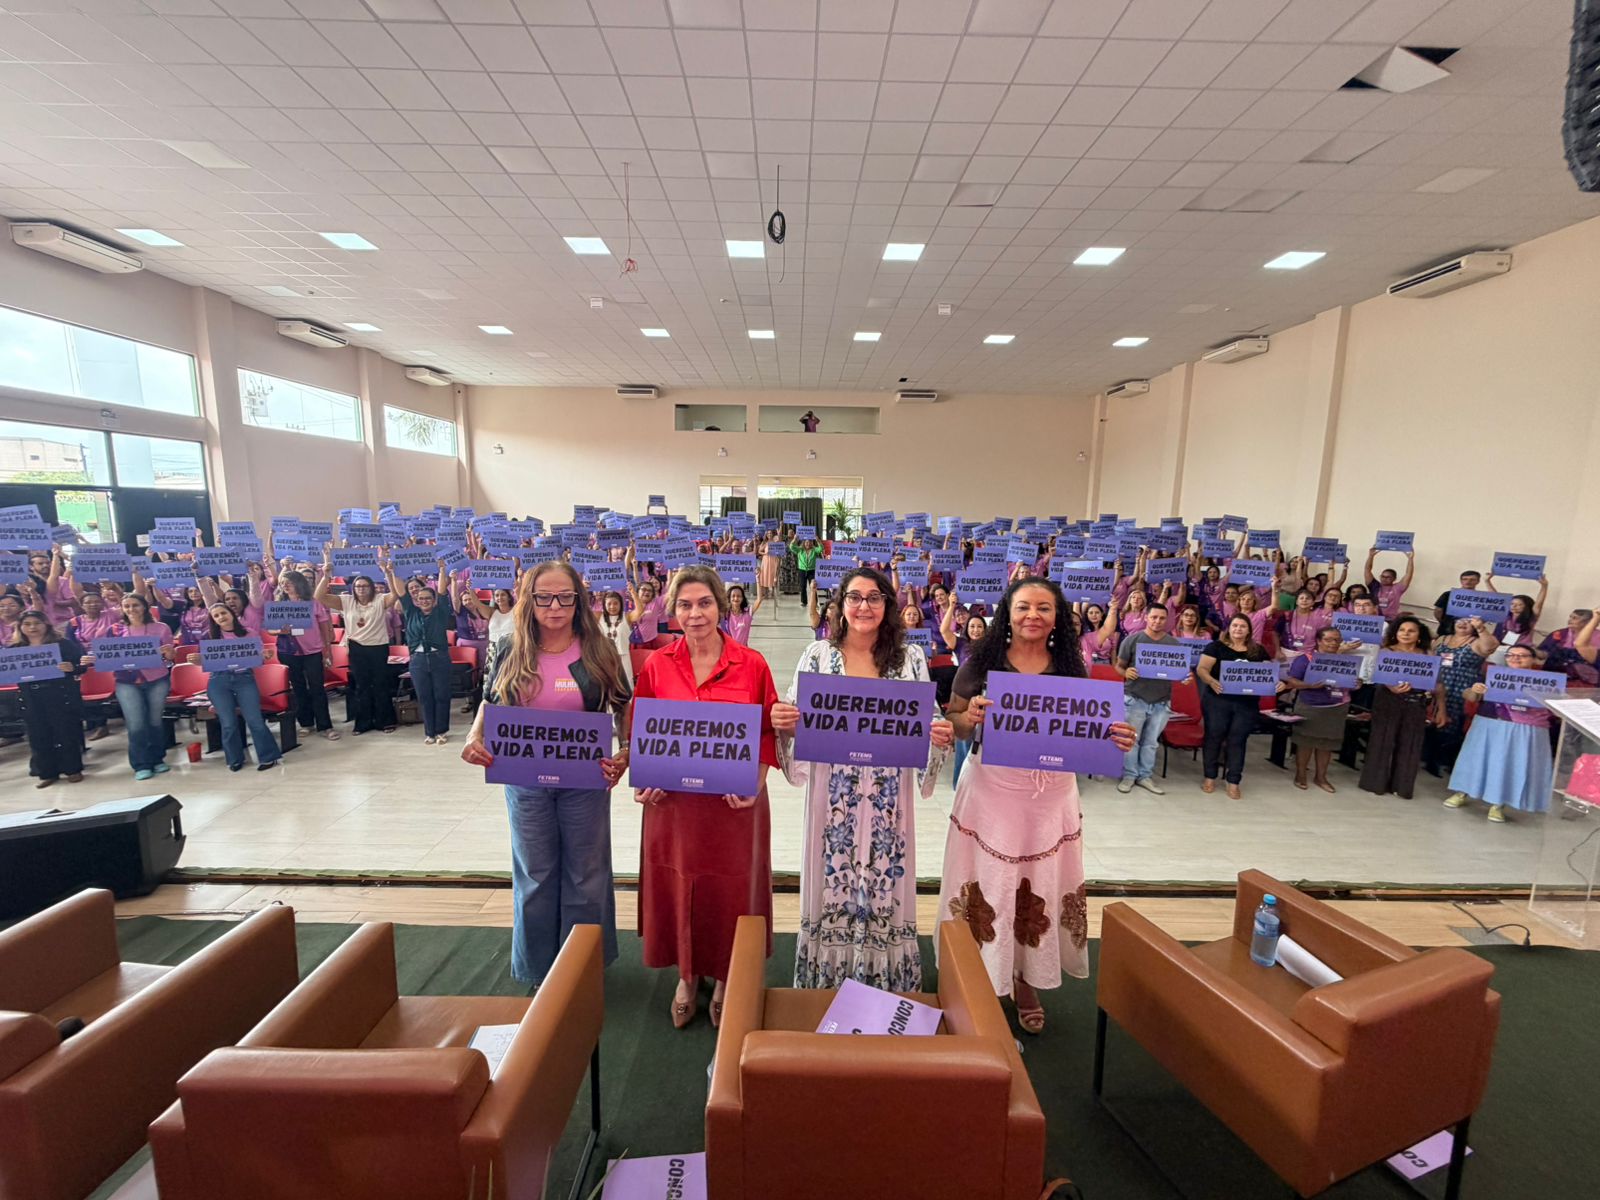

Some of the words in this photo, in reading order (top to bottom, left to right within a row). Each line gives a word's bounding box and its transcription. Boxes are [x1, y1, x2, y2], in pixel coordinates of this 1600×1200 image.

[218, 557, 244, 565] PLENA
[352, 558, 377, 566] PLENA
[1152, 561, 1184, 569] QUEREMOS
[1497, 557, 1540, 566] QUEREMOS
[76, 565, 97, 573] VIDA
[101, 565, 129, 573] PLENA
[589, 567, 621, 575] QUEREMOS
[1235, 563, 1270, 571] QUEREMOS
[1232, 568, 1248, 576] VIDA
[1067, 574, 1110, 583] QUEREMOS
[958, 584, 976, 592] VIDA
[1063, 582, 1083, 590] VIDA
[1084, 583, 1110, 591] PLENA
[1455, 594, 1505, 605] QUEREMOS
[1451, 600, 1472, 609] VIDA
[1475, 603, 1506, 612] PLENA
[1337, 618, 1378, 627] QUEREMOS
[1354, 626, 1379, 634] PLENA
[99, 642, 153, 651] QUEREMOS
[206, 643, 255, 652] QUEREMOS
[0, 652, 52, 663] UEREMOS
[96, 650, 121, 659] VIDA
[125, 649, 157, 657] PLENA
[229, 650, 259, 658] PLENA
[1141, 650, 1185, 659] QUEREMOS
[0, 663, 17, 671] DA
[1160, 659, 1187, 668] PLENA
[1315, 658, 1356, 668] QUEREMOS
[1383, 657, 1433, 669] QUEREMOS
[1226, 667, 1273, 675] QUEREMOS
[1310, 665, 1328, 673] VIDA
[1330, 667, 1357, 676] PLENA
[1378, 664, 1400, 673] VIDA
[1403, 668, 1434, 677] PLENA
[1245, 675, 1274, 683] PLENA
[1494, 673, 1557, 687] QUEREMOS
[1489, 681, 1516, 690] VIDA
[810, 693, 919, 716] QUEREMOS
[1001, 693, 1111, 718] QUEREMOS
[646, 718, 746, 739] QUEREMOS
[803, 712, 848, 732] VIDA
[858, 717, 922, 737] PLENA
[992, 713, 1039, 733] VIDA
[1049, 719, 1113, 740] PLENA
[497, 723, 599, 743] QUEREMOS
[491, 741, 534, 758] VIDA
[543, 745, 604, 760] PLENA
[638, 738, 680, 757] VIDA
[689, 742, 751, 761] PLENA
[666, 1159, 685, 1200] CONC
